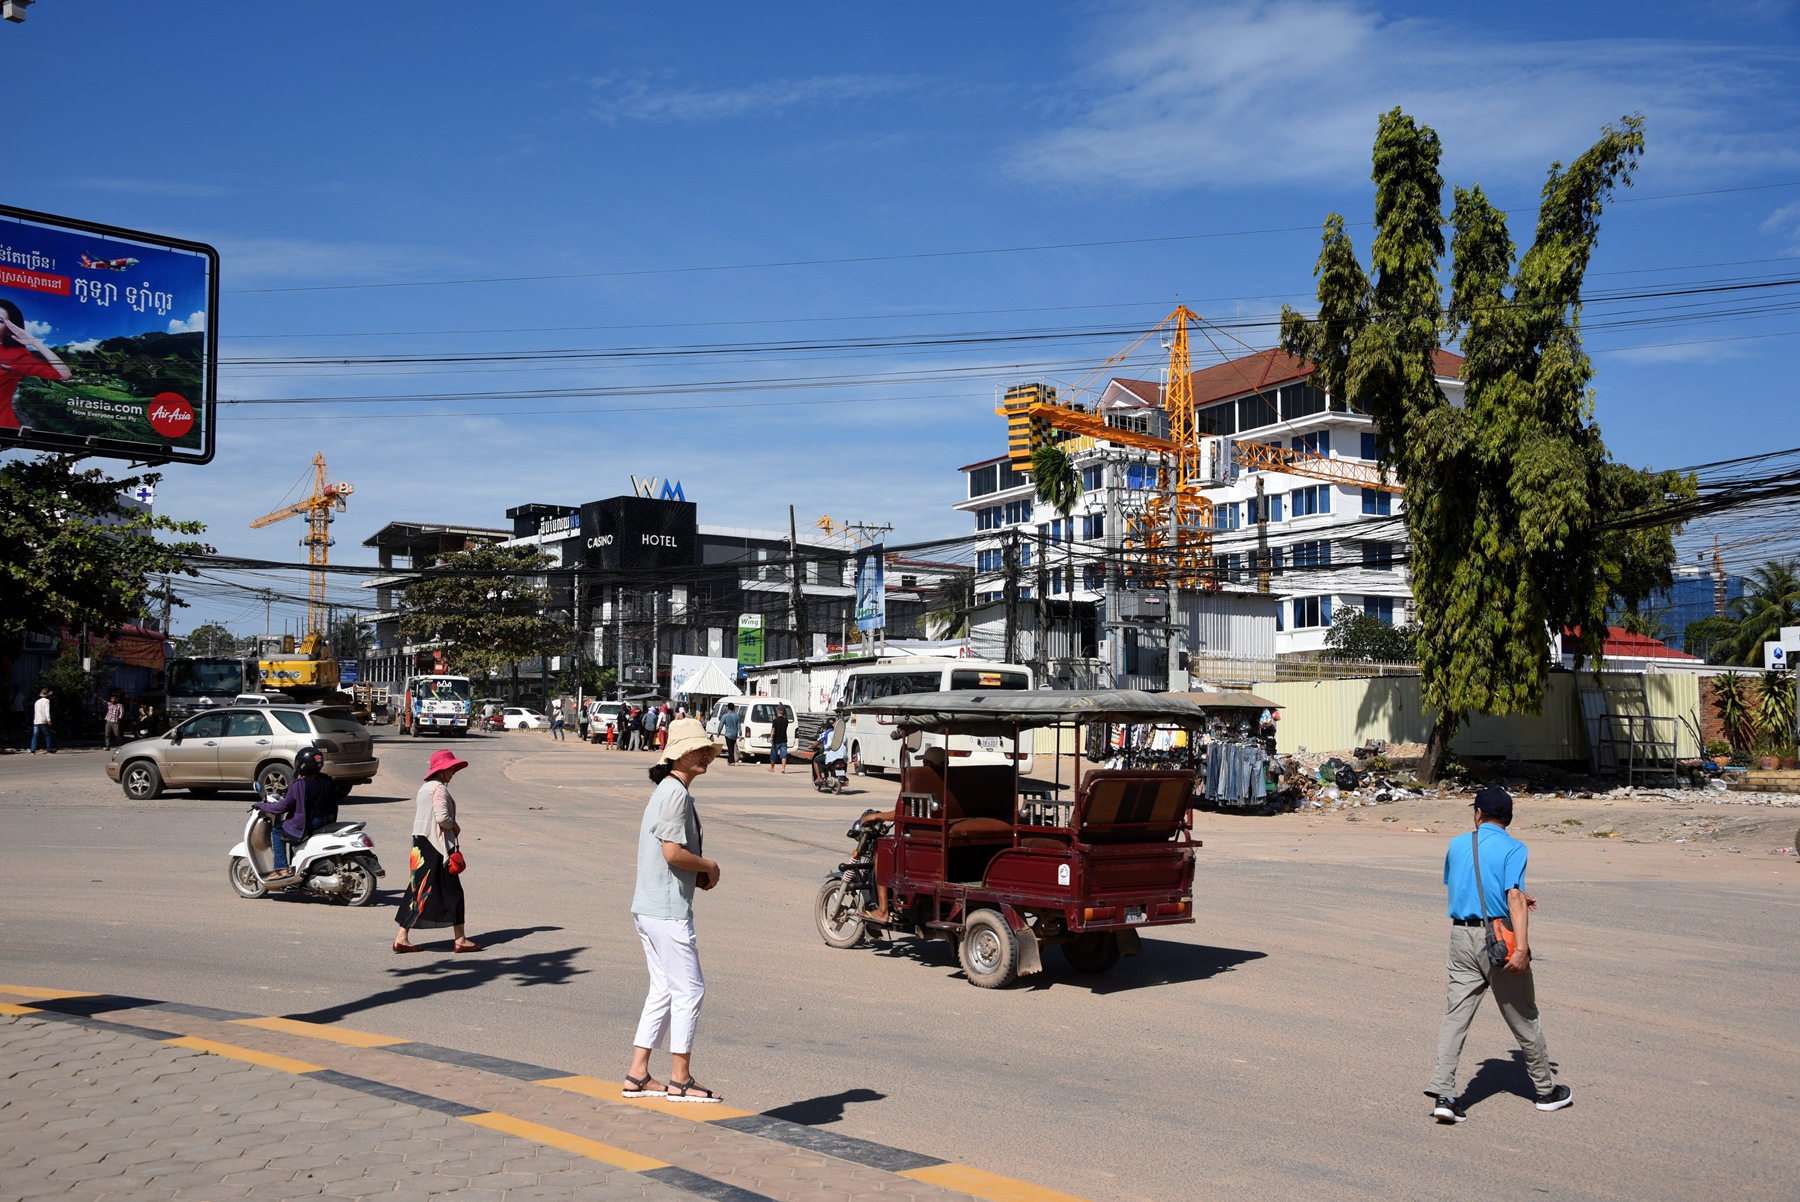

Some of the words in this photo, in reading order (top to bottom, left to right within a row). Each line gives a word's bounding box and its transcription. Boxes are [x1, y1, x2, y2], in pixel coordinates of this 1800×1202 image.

[67, 396, 143, 415] airasia.com
[87, 410, 115, 420] Everyone
[128, 415, 137, 423] Fly
[587, 534, 613, 549] CASINO
[641, 534, 678, 548] HOTEL
[741, 618, 759, 627] Wing
[270, 670, 301, 679] XCMG
